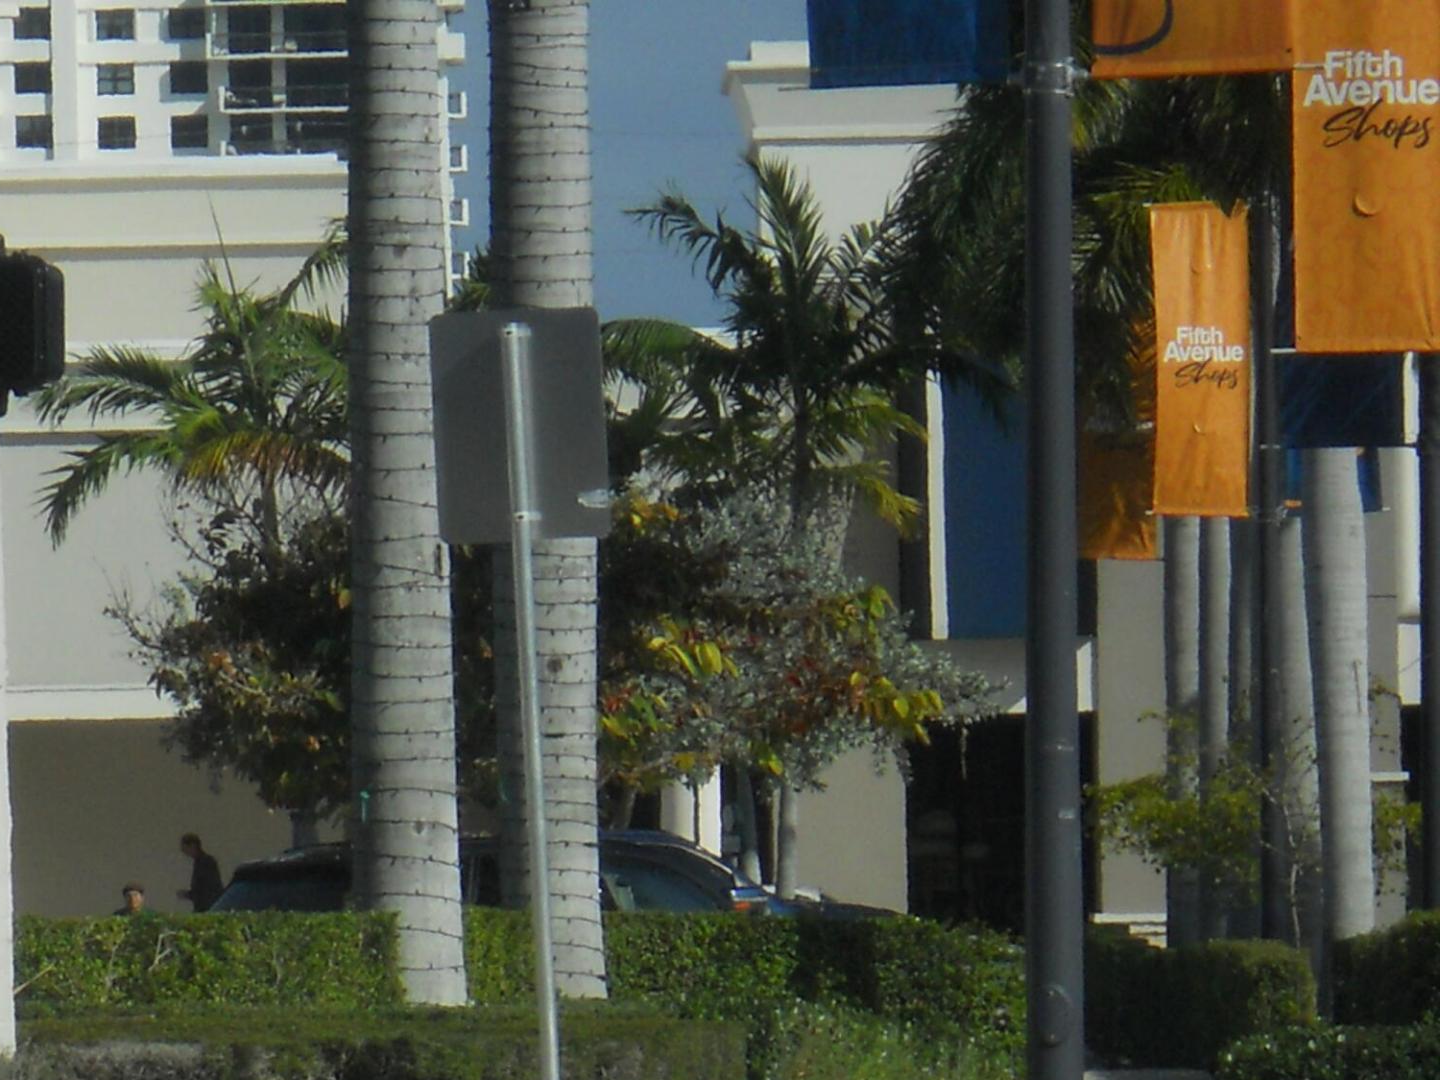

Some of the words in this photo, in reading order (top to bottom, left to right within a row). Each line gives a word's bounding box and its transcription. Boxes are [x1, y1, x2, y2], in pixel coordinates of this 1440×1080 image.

[1324, 49, 1403, 79] Fifth
[1303, 73, 1440, 107] Avenue
[1322, 98, 1432, 149] Shops
[1176, 325, 1224, 345] Fifth
[1163, 340, 1245, 363] Avenue
[1174, 357, 1239, 390] Shops
